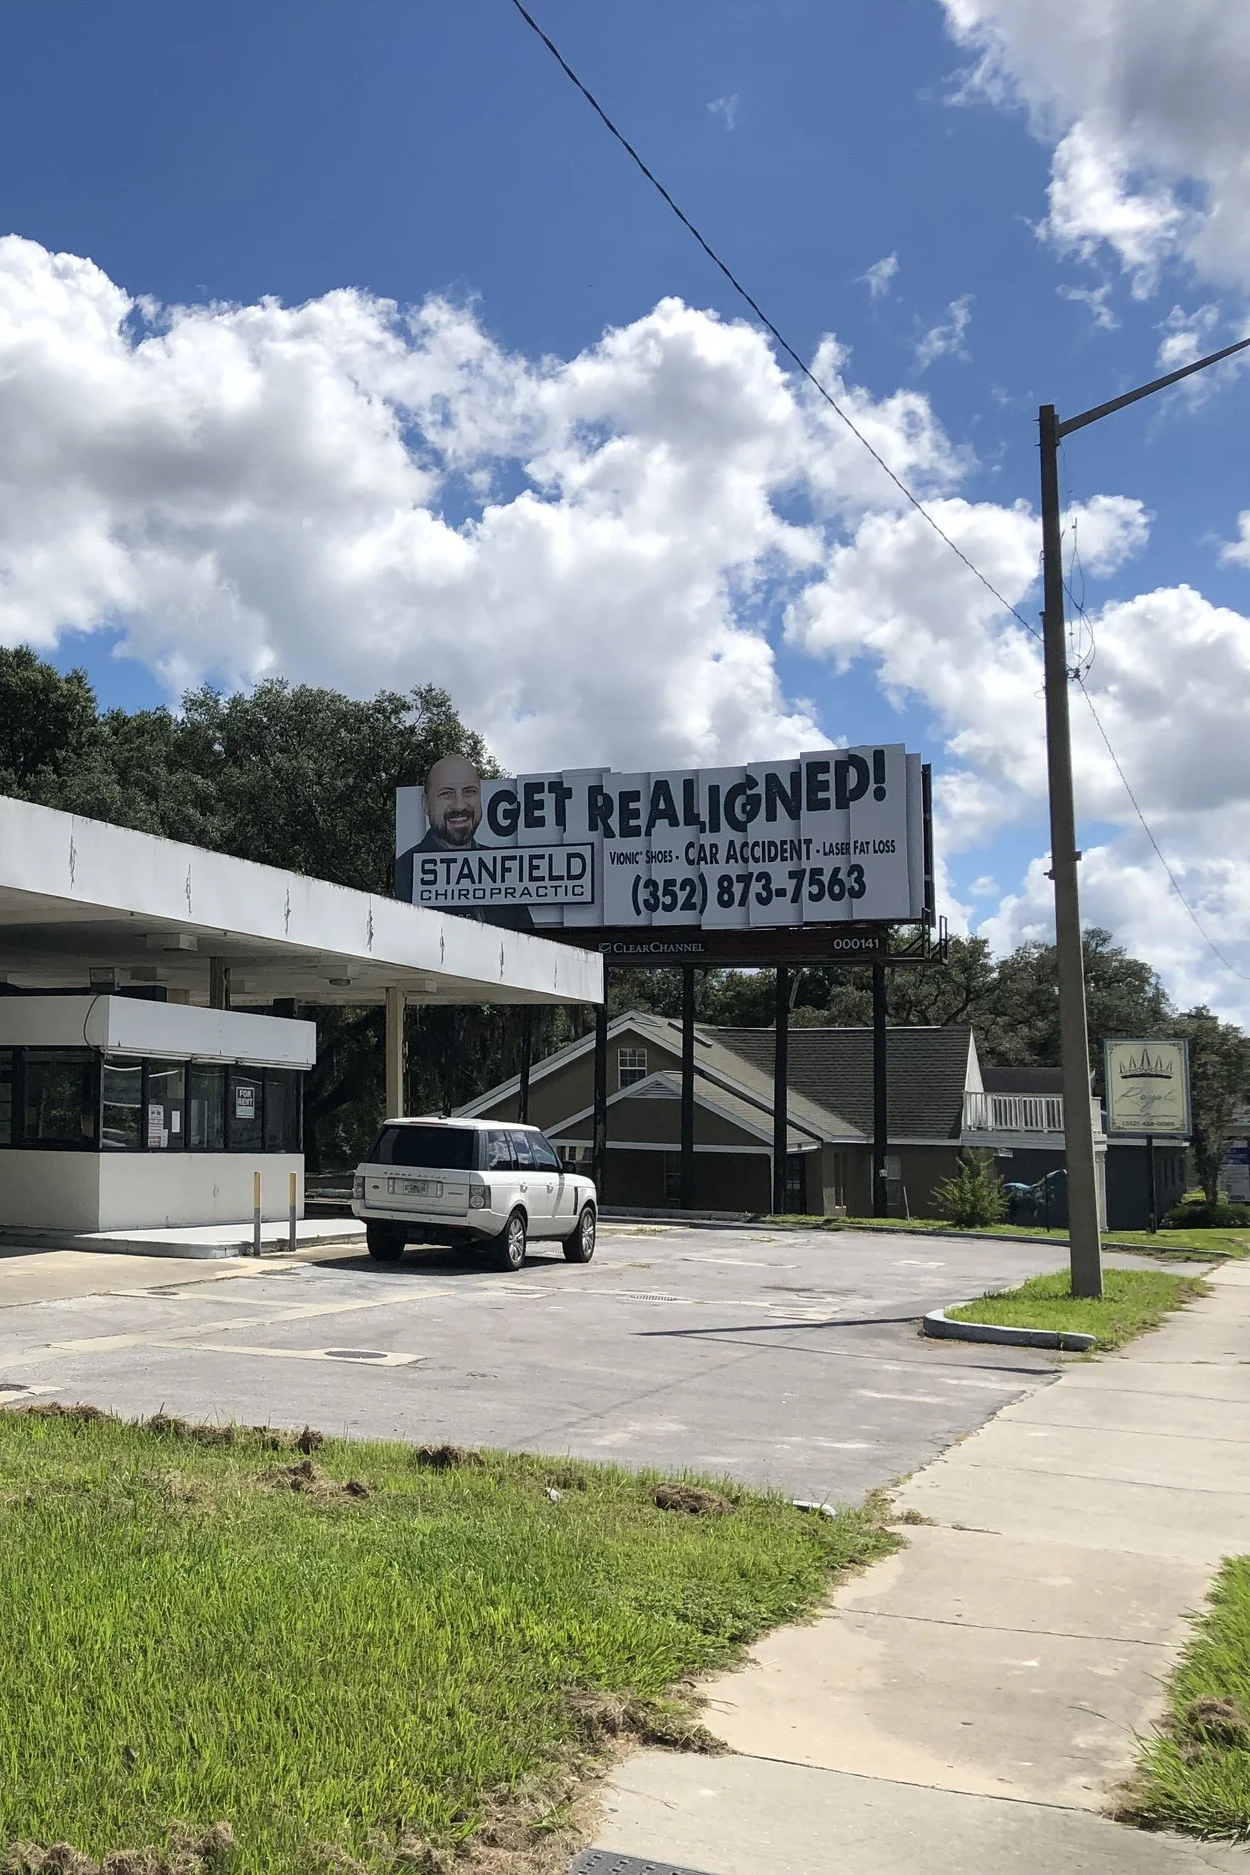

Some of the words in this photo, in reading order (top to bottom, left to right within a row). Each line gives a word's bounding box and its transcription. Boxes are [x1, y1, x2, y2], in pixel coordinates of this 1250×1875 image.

[487, 780, 573, 837] GET
[587, 749, 887, 839] REALIGNED!
[645, 849, 673, 865] SHOES
[684, 841, 720, 866] CAR
[725, 838, 813, 865] ACCIDENT
[822, 841, 851, 857] LASER
[853, 839, 871, 855] FAT
[872, 839, 896, 854] LOSS
[420, 852, 587, 886] STANFIELD
[420, 884, 585, 901] CHIROPRACTIC
[631, 871, 708, 917] (352)
[716, 863, 867, 909] 873-7563
[833, 938, 879, 950] 000141
[237, 1097, 253, 1106] RENT
[239, 1089, 252, 1098] FOR
